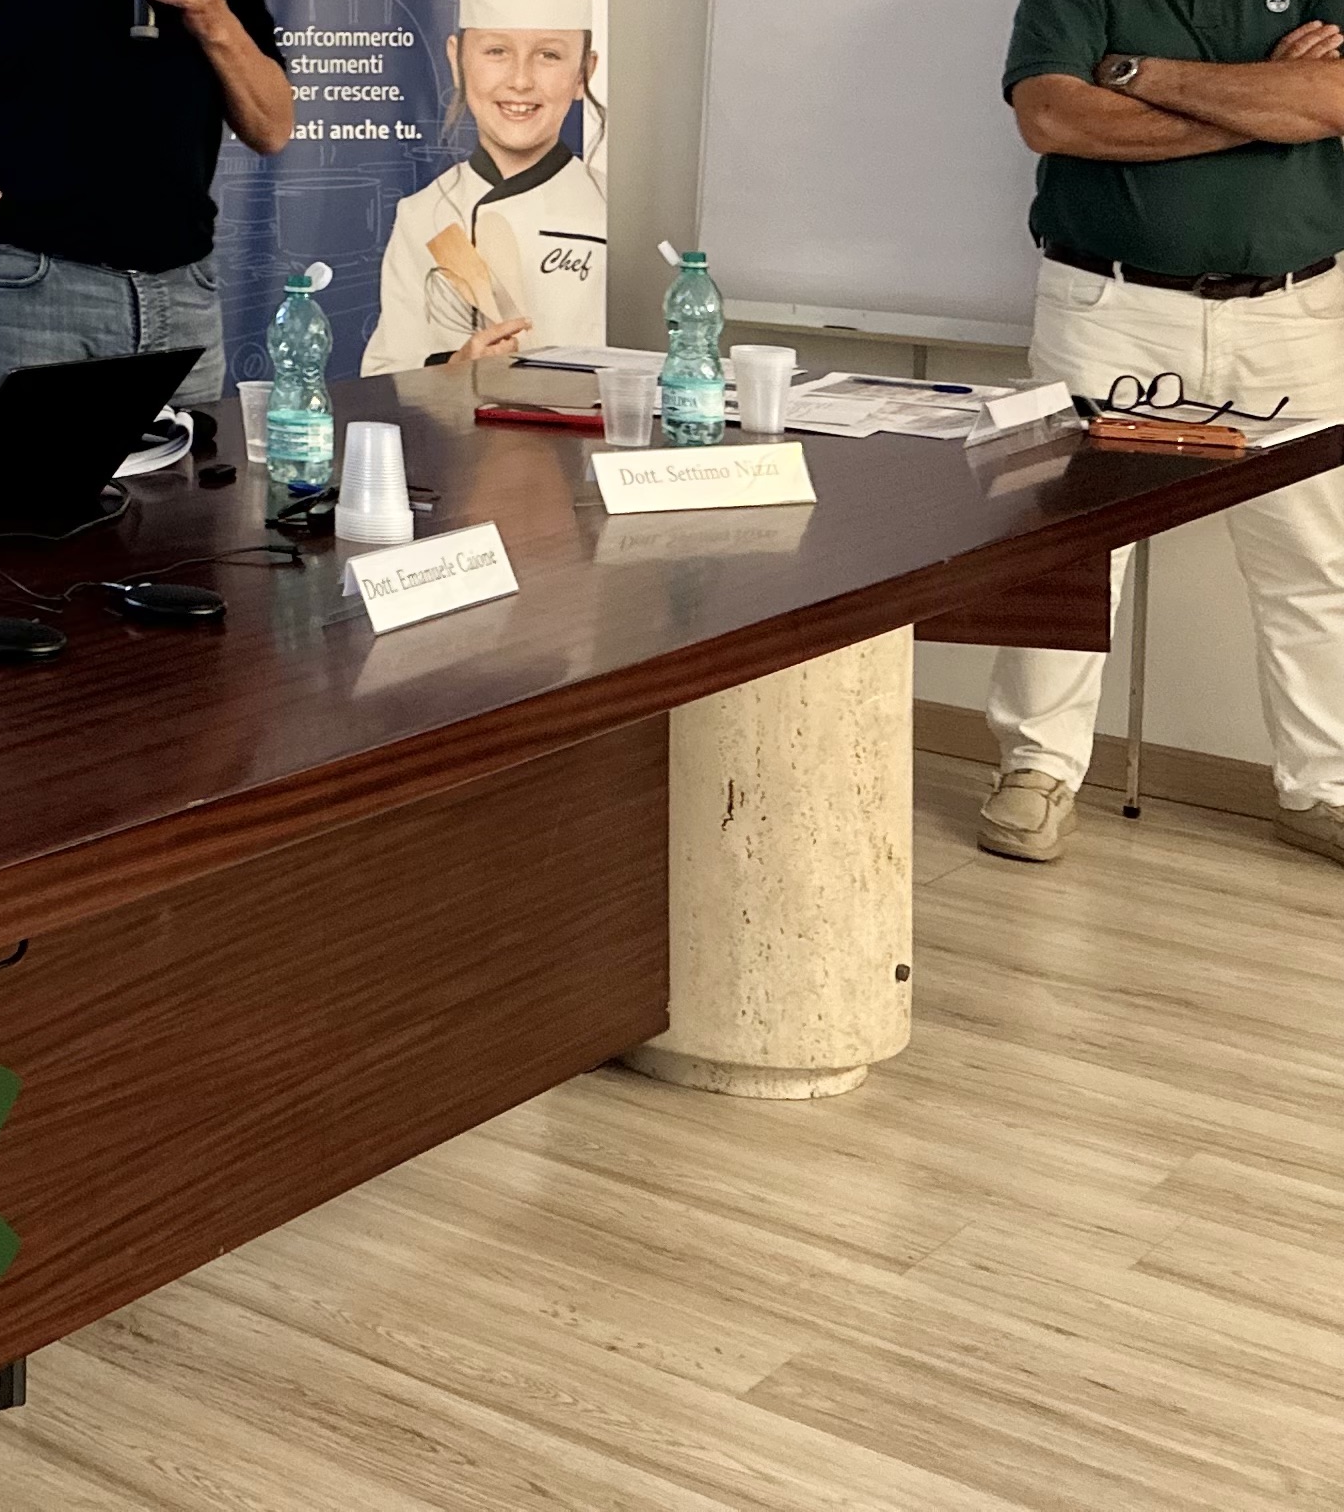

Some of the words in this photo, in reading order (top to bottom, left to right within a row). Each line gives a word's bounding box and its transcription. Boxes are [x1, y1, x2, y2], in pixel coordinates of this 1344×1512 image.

[291, 54, 383, 74] strumenti
[324, 85, 404, 101] crescere.
[330, 119, 392, 140] anche
[394, 120, 422, 140] tu.
[539, 248, 593, 281] Chef
[619, 467, 662, 486] Dott.
[666, 464, 730, 483] Settimo
[362, 576, 398, 600] Dott.
[397, 557, 456, 590] Emanuele
[456, 549, 497, 573] Caione
